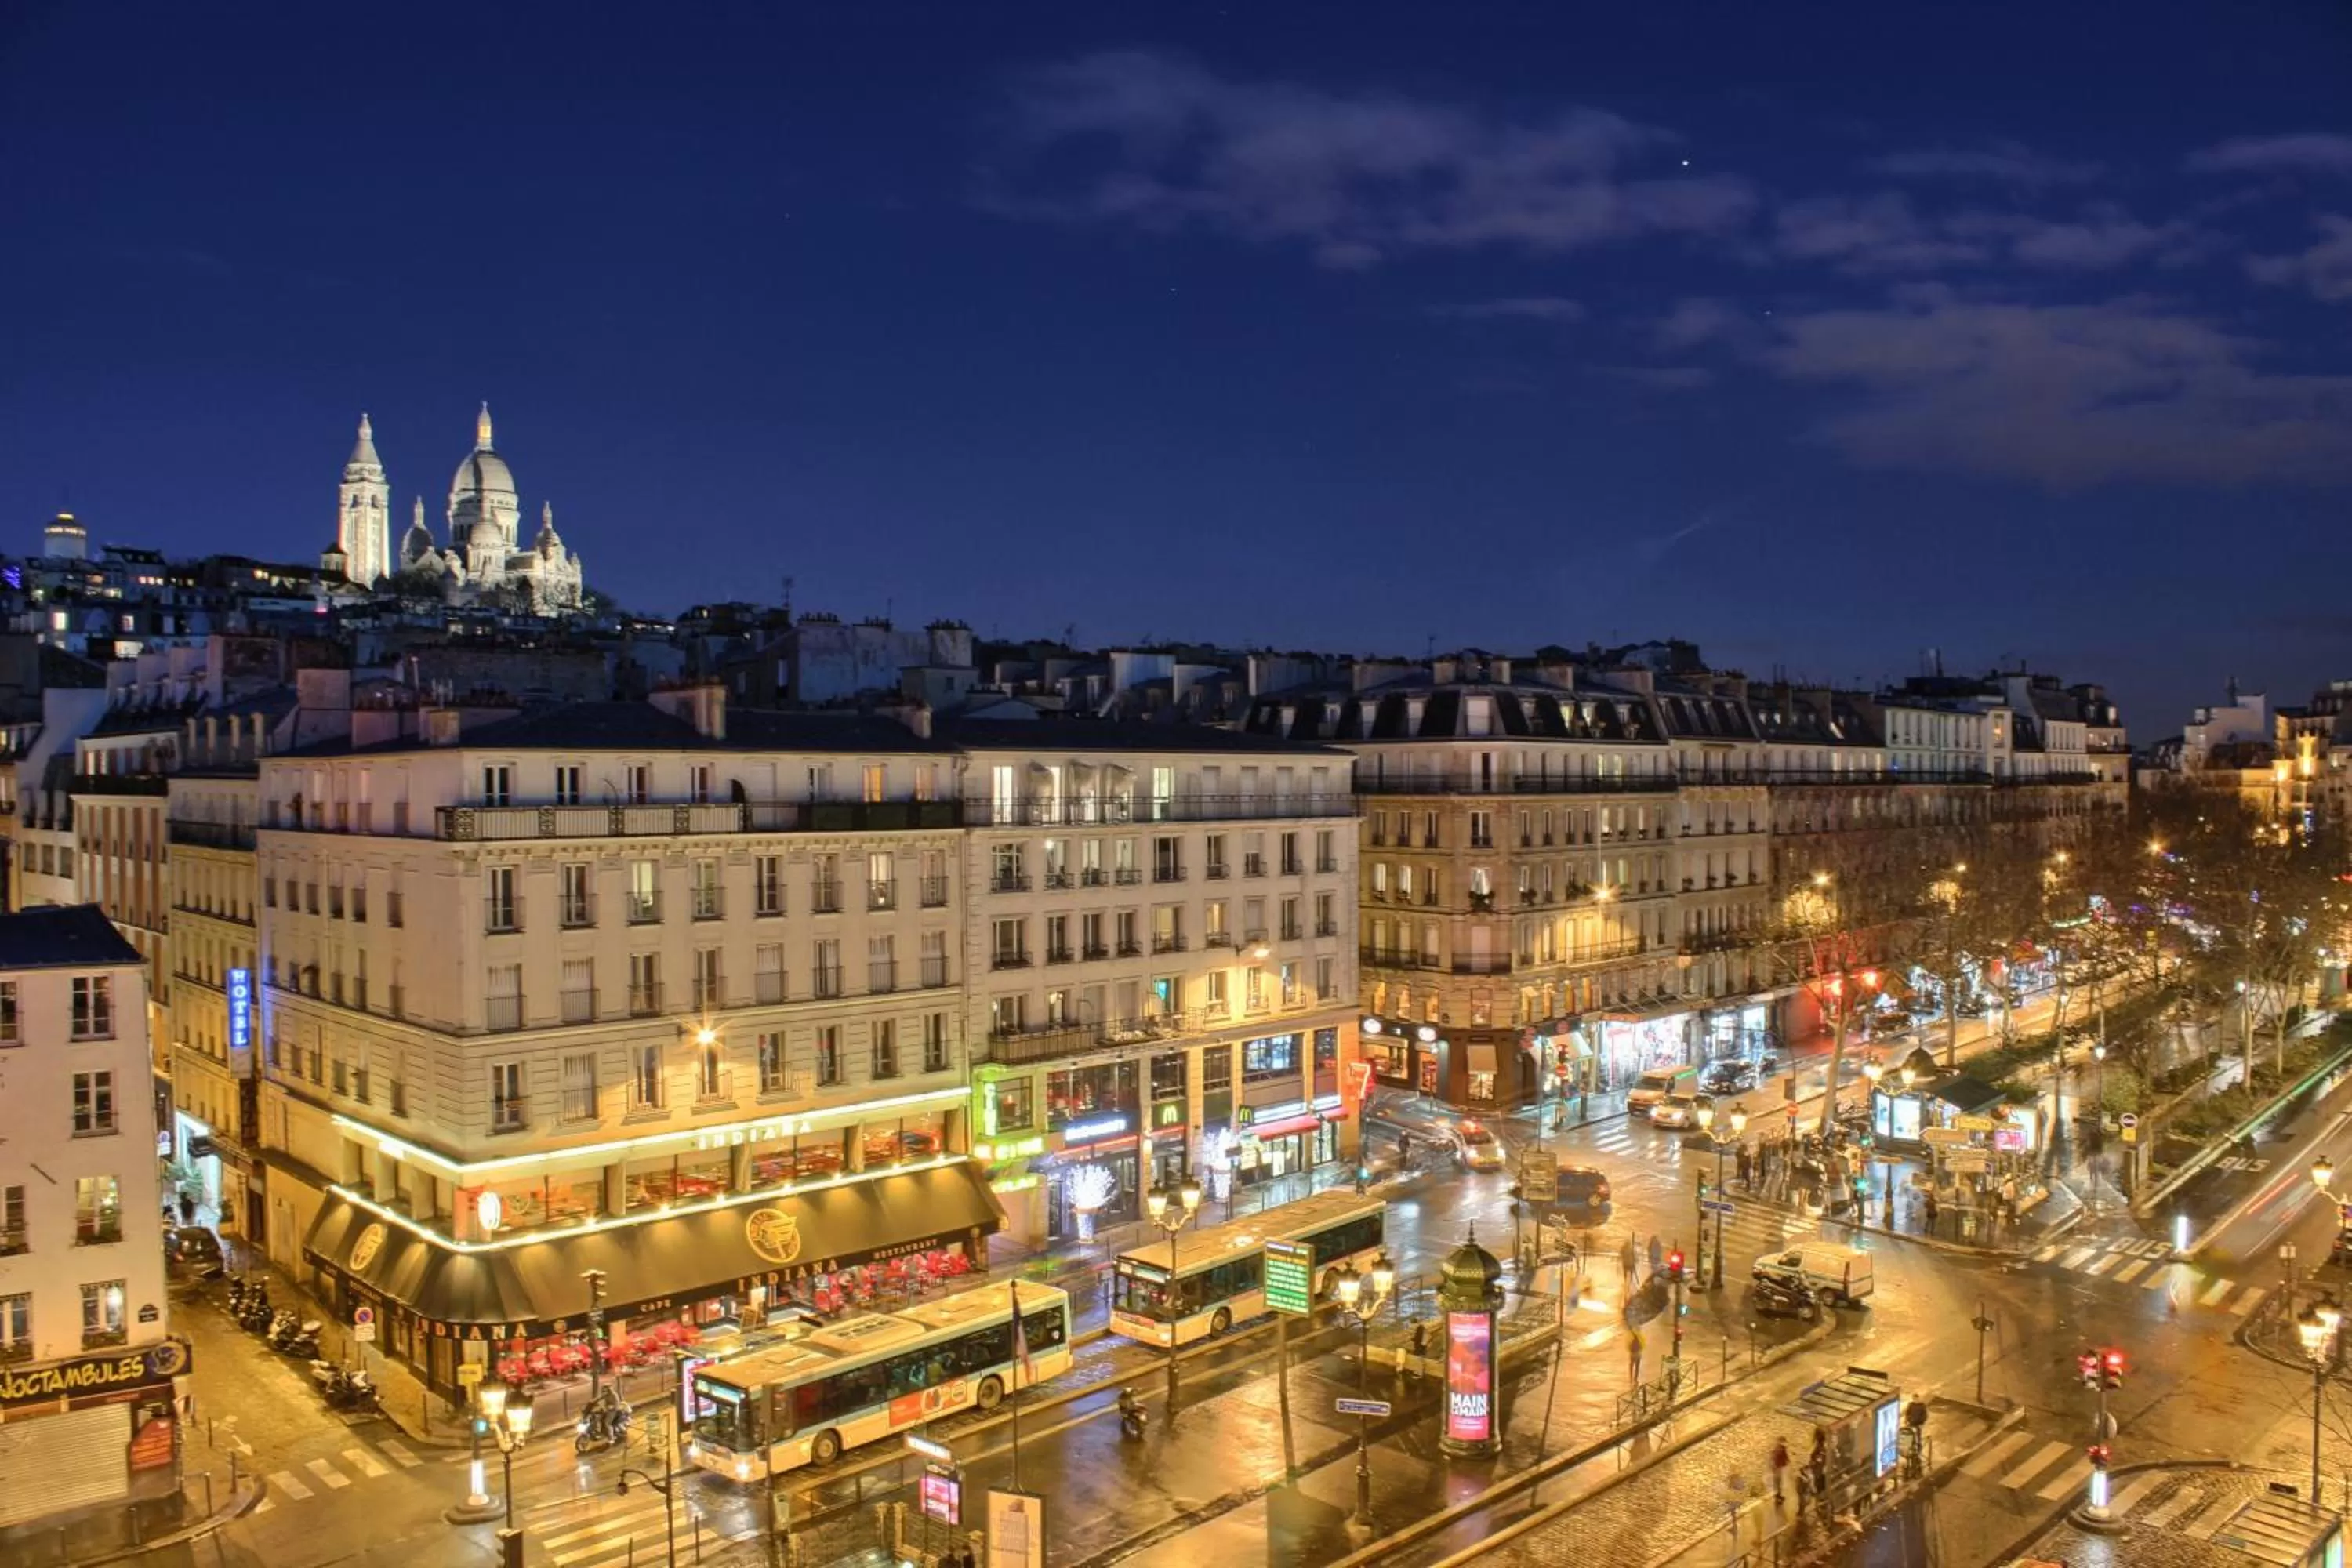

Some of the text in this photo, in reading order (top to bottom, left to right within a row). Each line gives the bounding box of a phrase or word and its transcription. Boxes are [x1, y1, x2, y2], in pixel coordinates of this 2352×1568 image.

[231, 967, 248, 1046] HOTEL
[698, 1118, 814, 1151] INDIANA
[2214, 1156, 2271, 1173] BUS
[873, 1238, 938, 1260] RESTAURANT
[2106, 1236, 2173, 1258] BUS
[738, 1258, 838, 1293] INDIANA
[413, 1315, 528, 1341] INDIANA
[1450, 1392, 1487, 1408] MAIN
